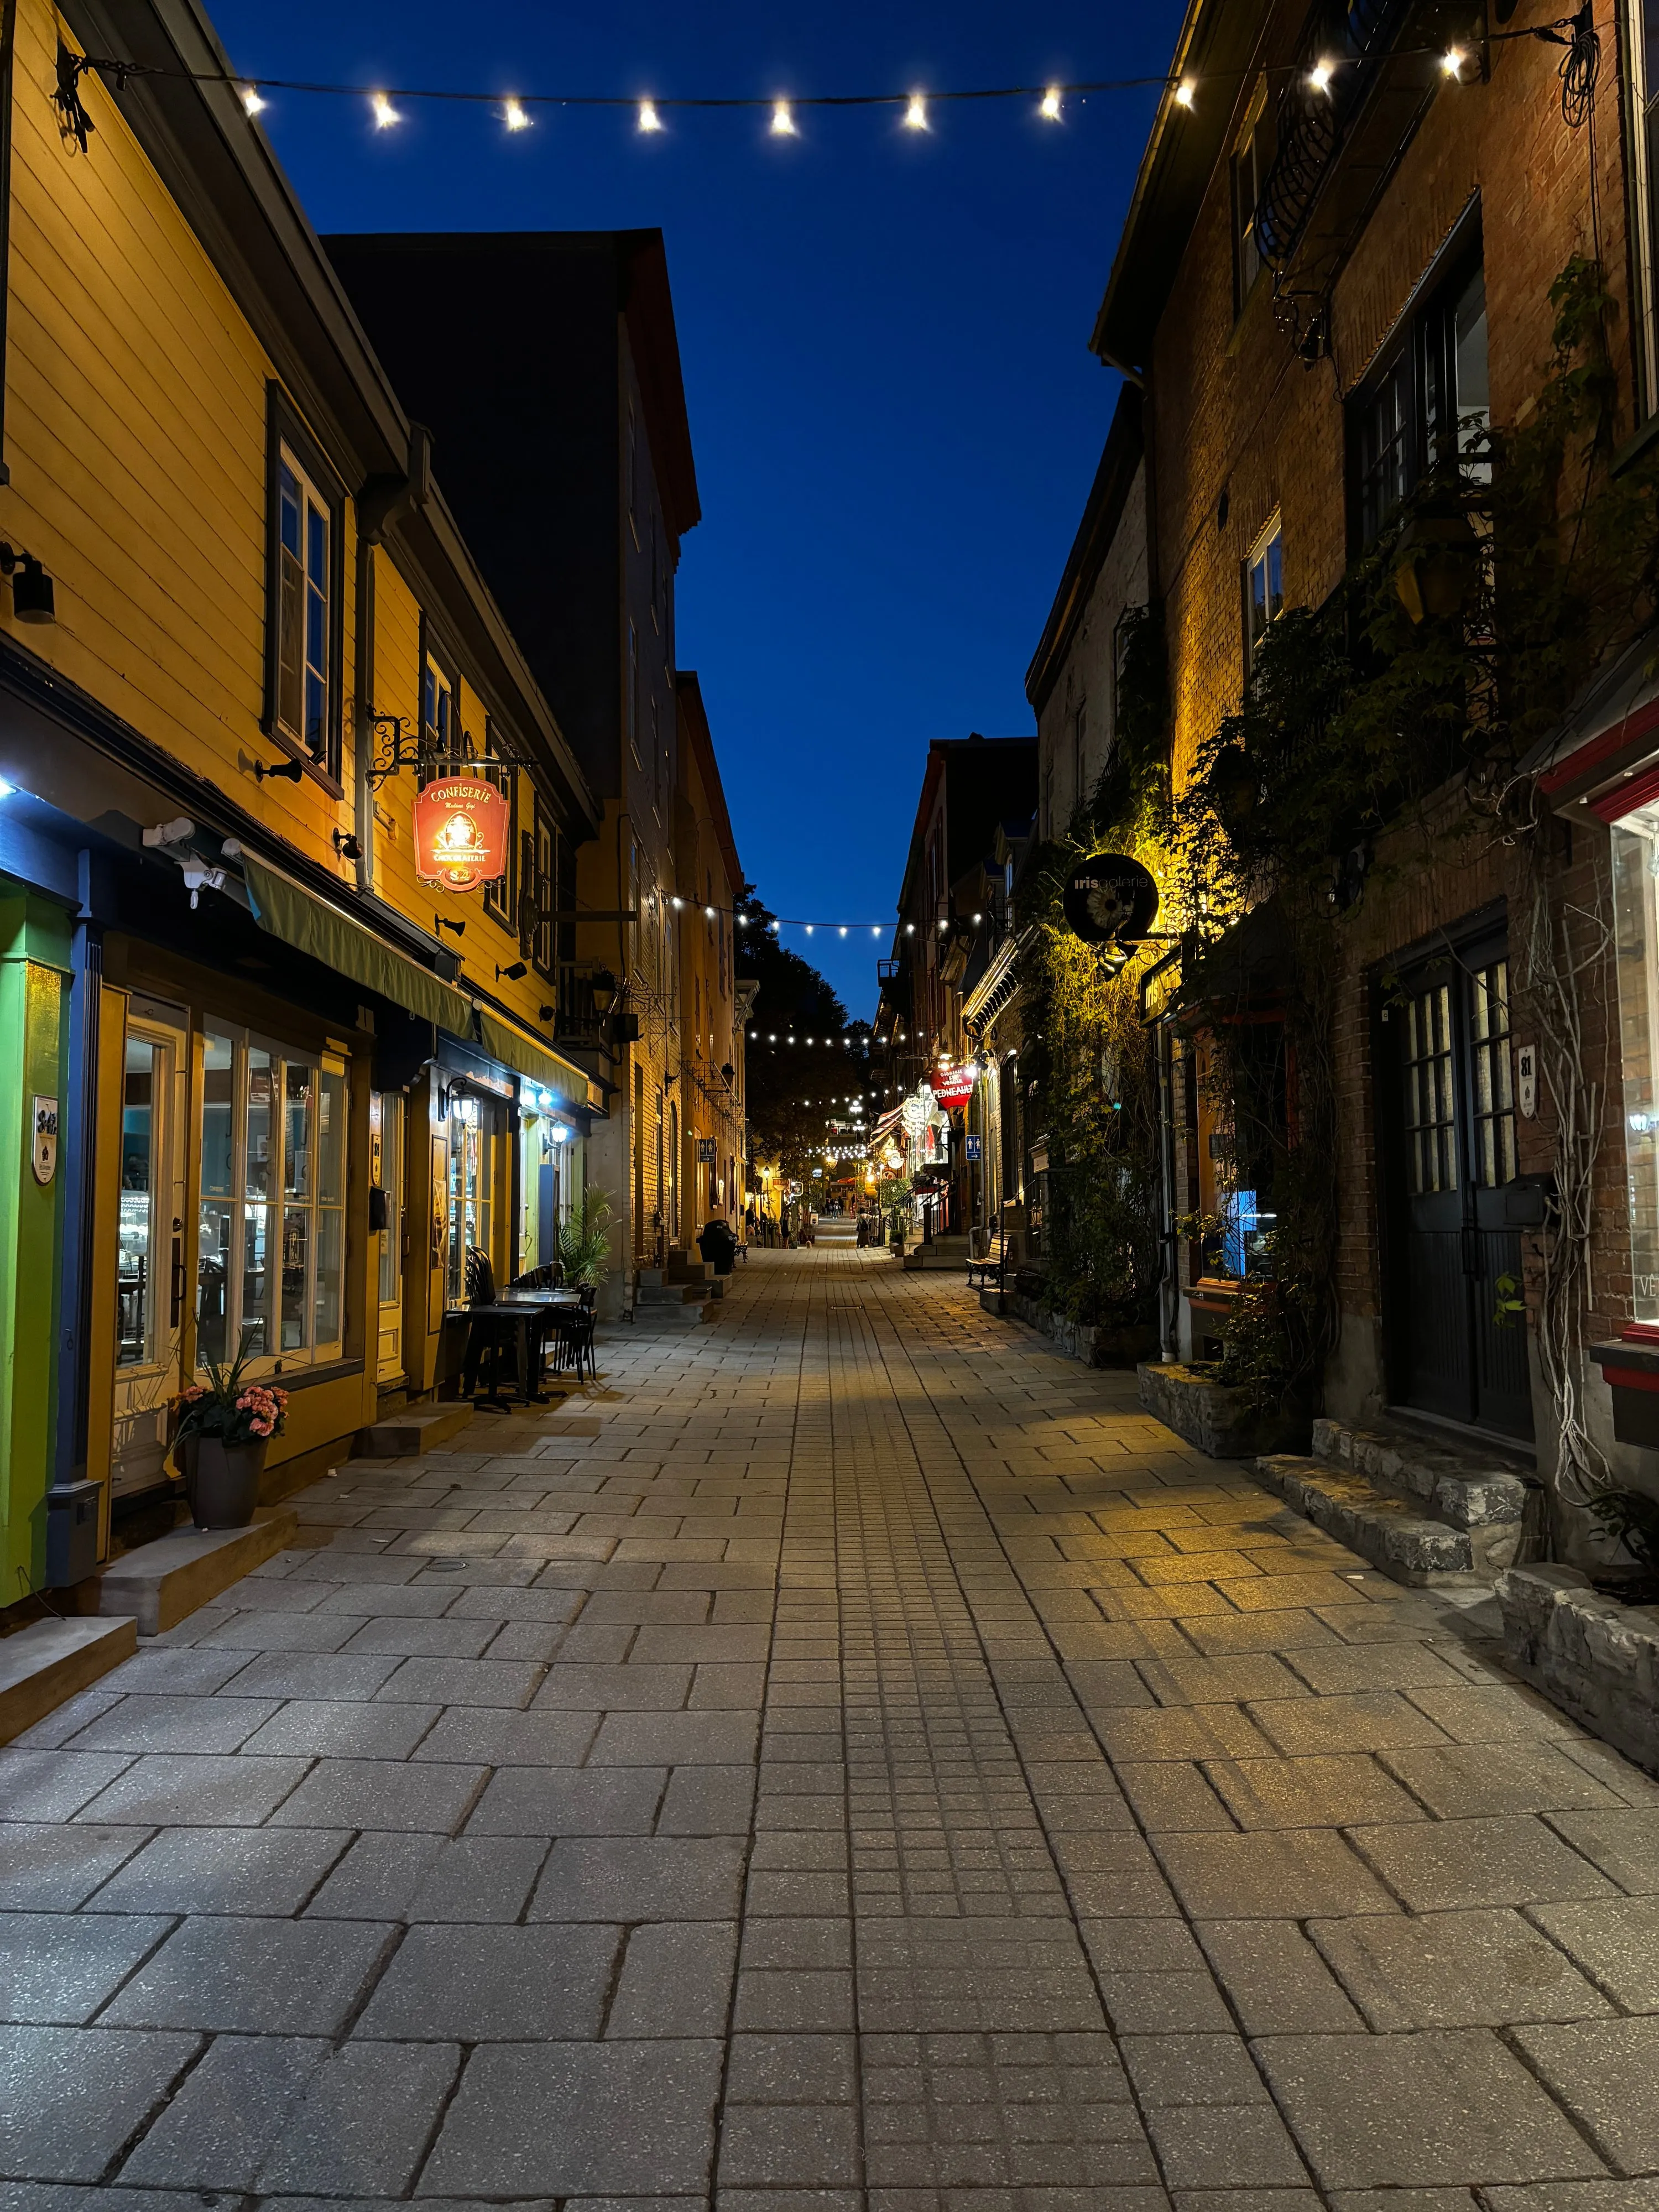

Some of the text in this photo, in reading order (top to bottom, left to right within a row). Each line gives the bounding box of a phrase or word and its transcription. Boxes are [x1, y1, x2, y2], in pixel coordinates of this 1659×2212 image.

[430, 782, 492, 804] CONFISERIE
[1521, 1056, 1532, 1077] 81
[932, 1084, 973, 1098] PEDNEAULT
